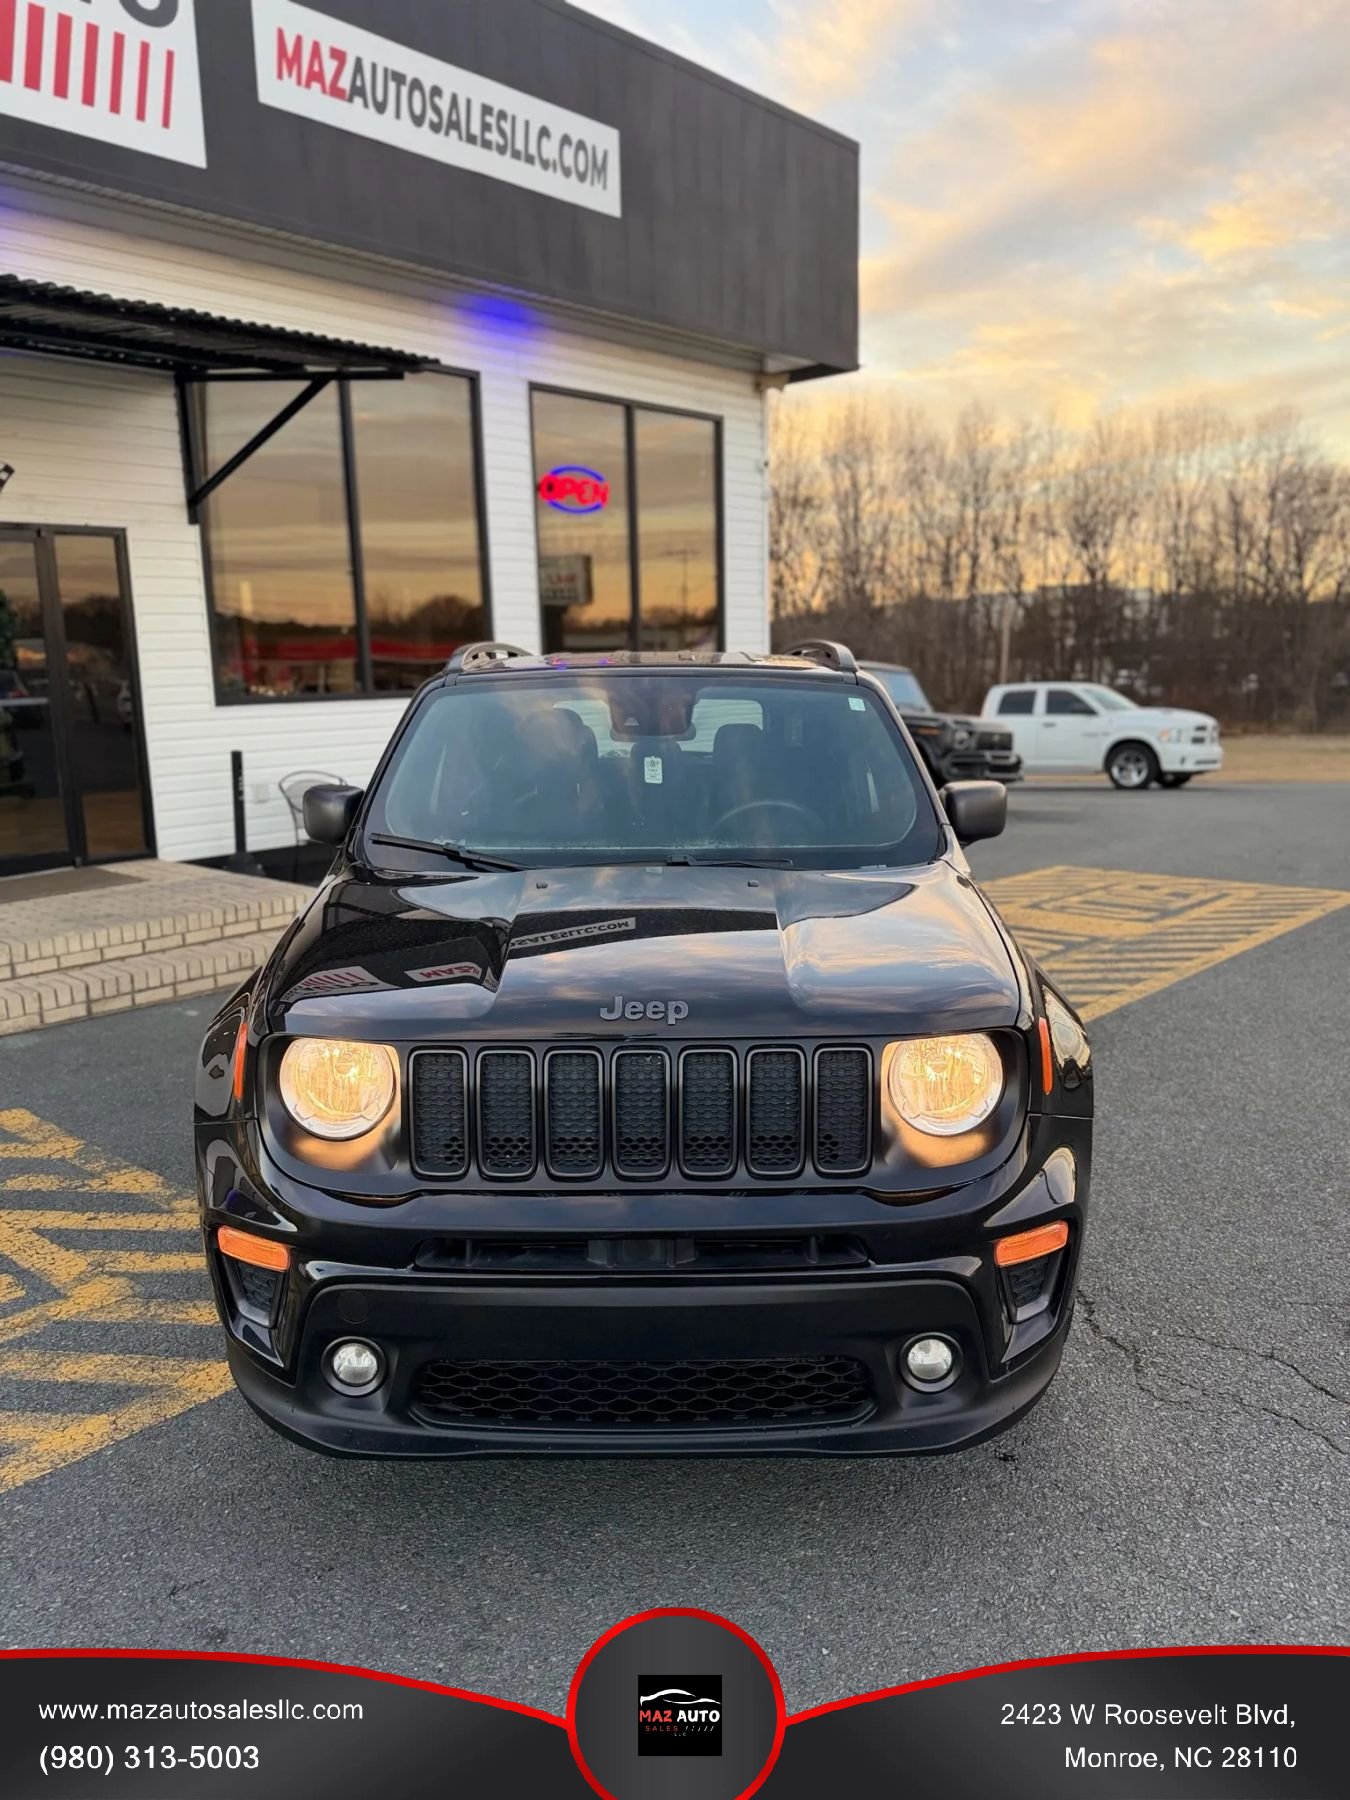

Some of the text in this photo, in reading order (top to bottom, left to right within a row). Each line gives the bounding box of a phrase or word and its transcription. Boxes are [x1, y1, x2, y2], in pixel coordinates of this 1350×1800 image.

[276, 26, 608, 190] MAZAUTOSALESLLC.COM
[538, 474, 609, 507] OPEN
[600, 996, 688, 1025] Jeep
